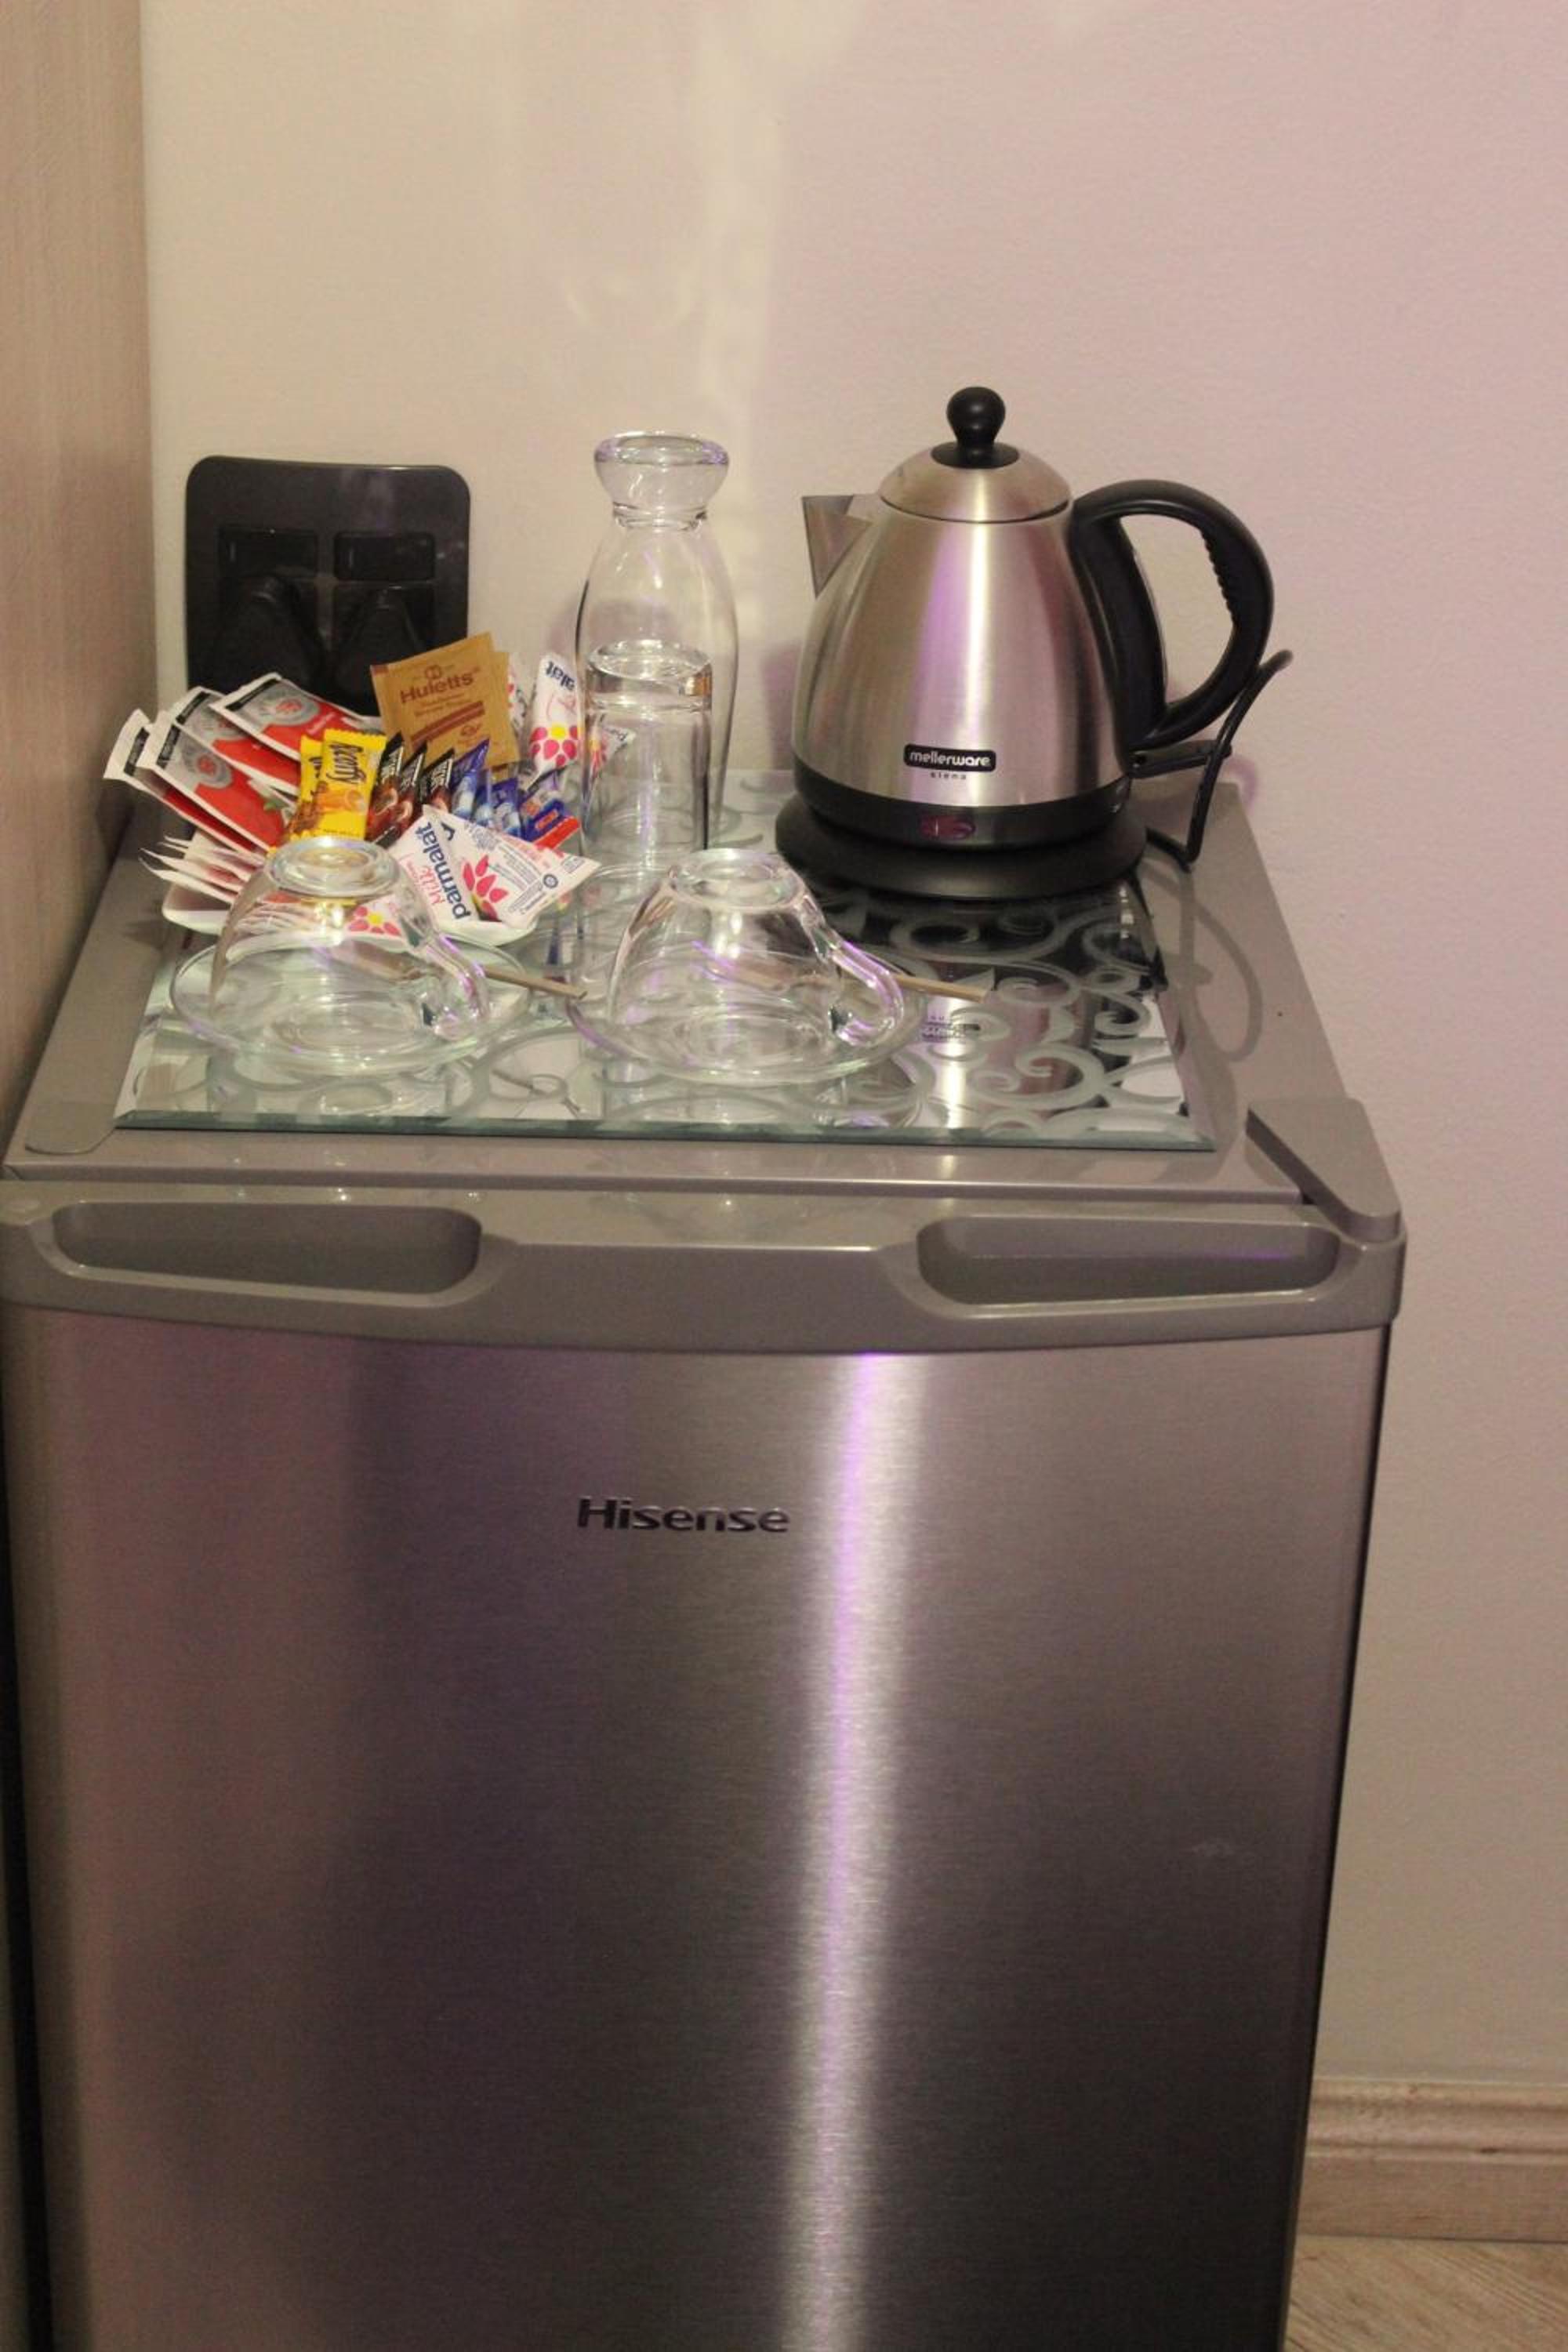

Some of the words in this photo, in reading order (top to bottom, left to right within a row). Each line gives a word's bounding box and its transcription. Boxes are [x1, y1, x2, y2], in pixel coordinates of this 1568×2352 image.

[400, 670, 474, 704] Huletts
[909, 750, 991, 767] mellerware
[416, 821, 472, 919] parmalat
[577, 1494, 789, 1534] Hisense
